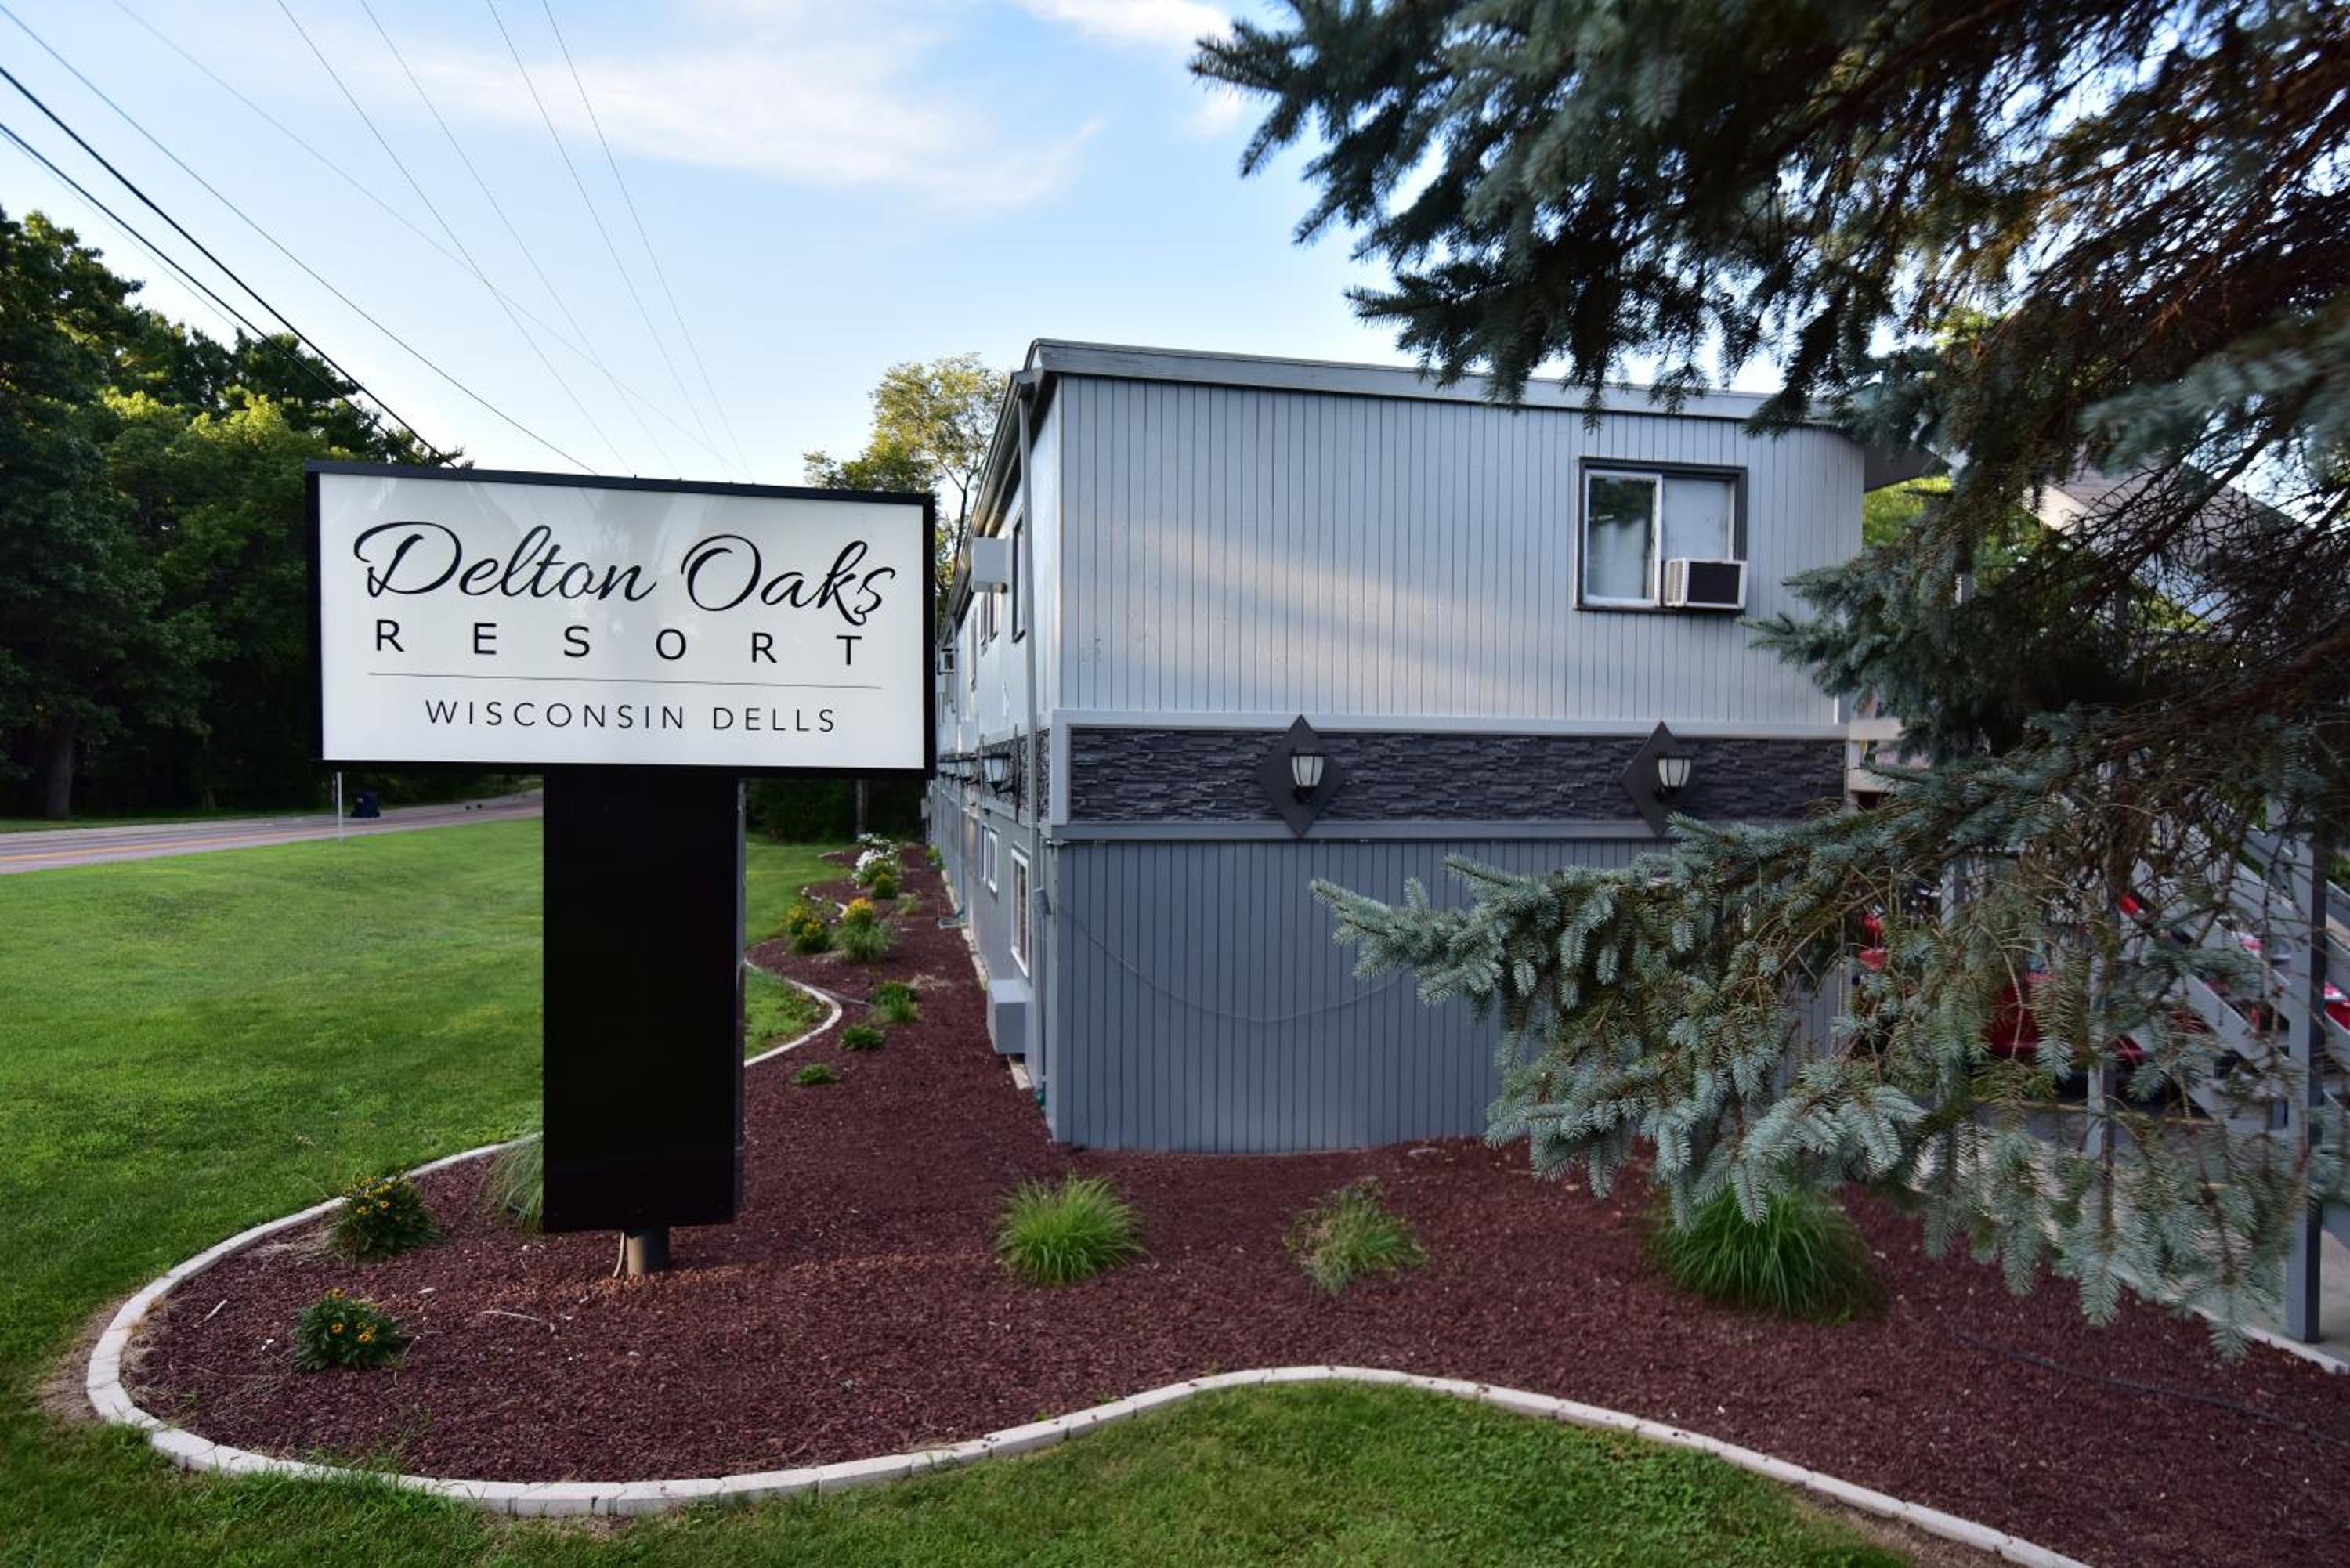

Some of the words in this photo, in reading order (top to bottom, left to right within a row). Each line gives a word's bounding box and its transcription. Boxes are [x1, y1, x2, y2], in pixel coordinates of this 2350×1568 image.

[353, 521, 657, 602] Delton
[680, 533, 896, 627] Oaks
[376, 619, 862, 666] RESORT
[425, 699, 685, 730] WISCONSIN
[713, 707, 837, 733] DELLS
